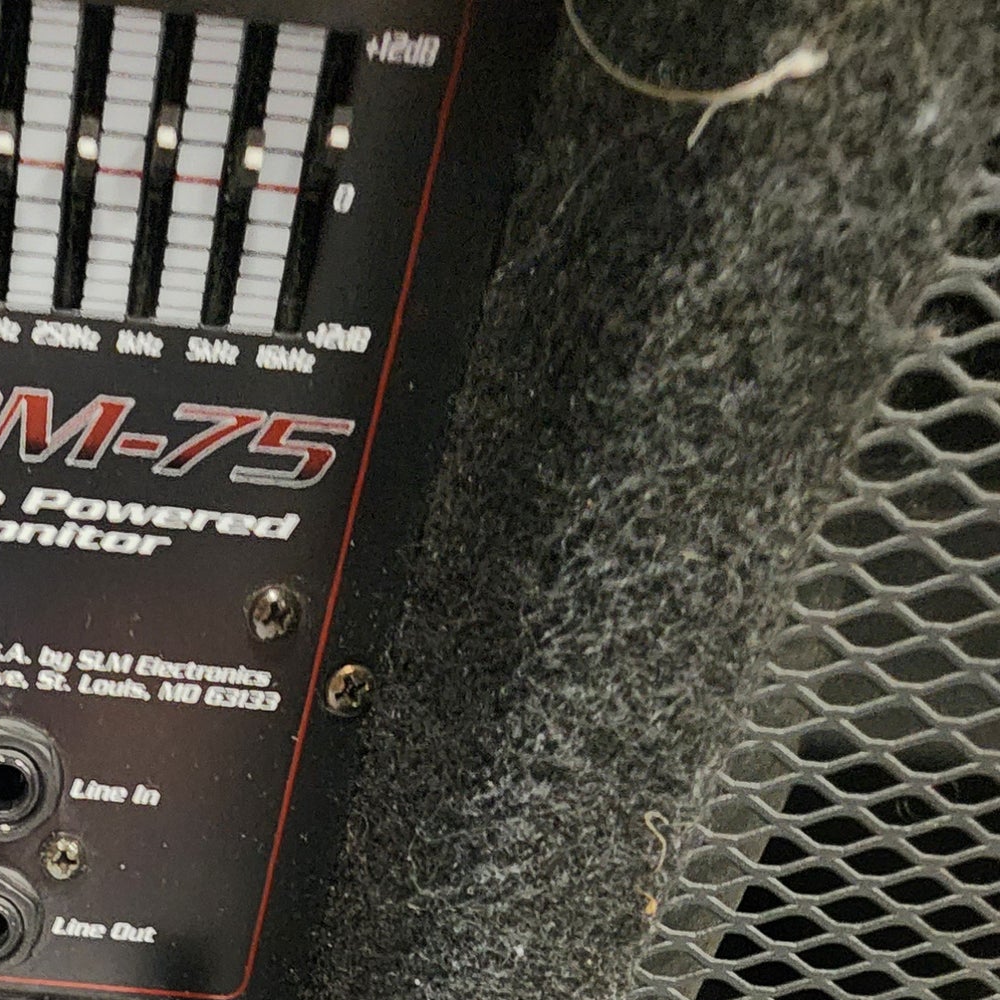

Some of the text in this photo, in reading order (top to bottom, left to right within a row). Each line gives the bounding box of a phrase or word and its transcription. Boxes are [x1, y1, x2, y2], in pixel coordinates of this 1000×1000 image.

[333, 183, 355, 214] 0
[21, 486, 300, 541] Powered
[38, 645, 74, 673] by
[76, 649, 135, 674] SLM
[135, 654, 272, 688] Electronics
[36, 669, 71, 692] St.
[158, 680, 202, 704] MO
[69, 777, 128, 803] Line
[51, 916, 157, 943] Line Out
